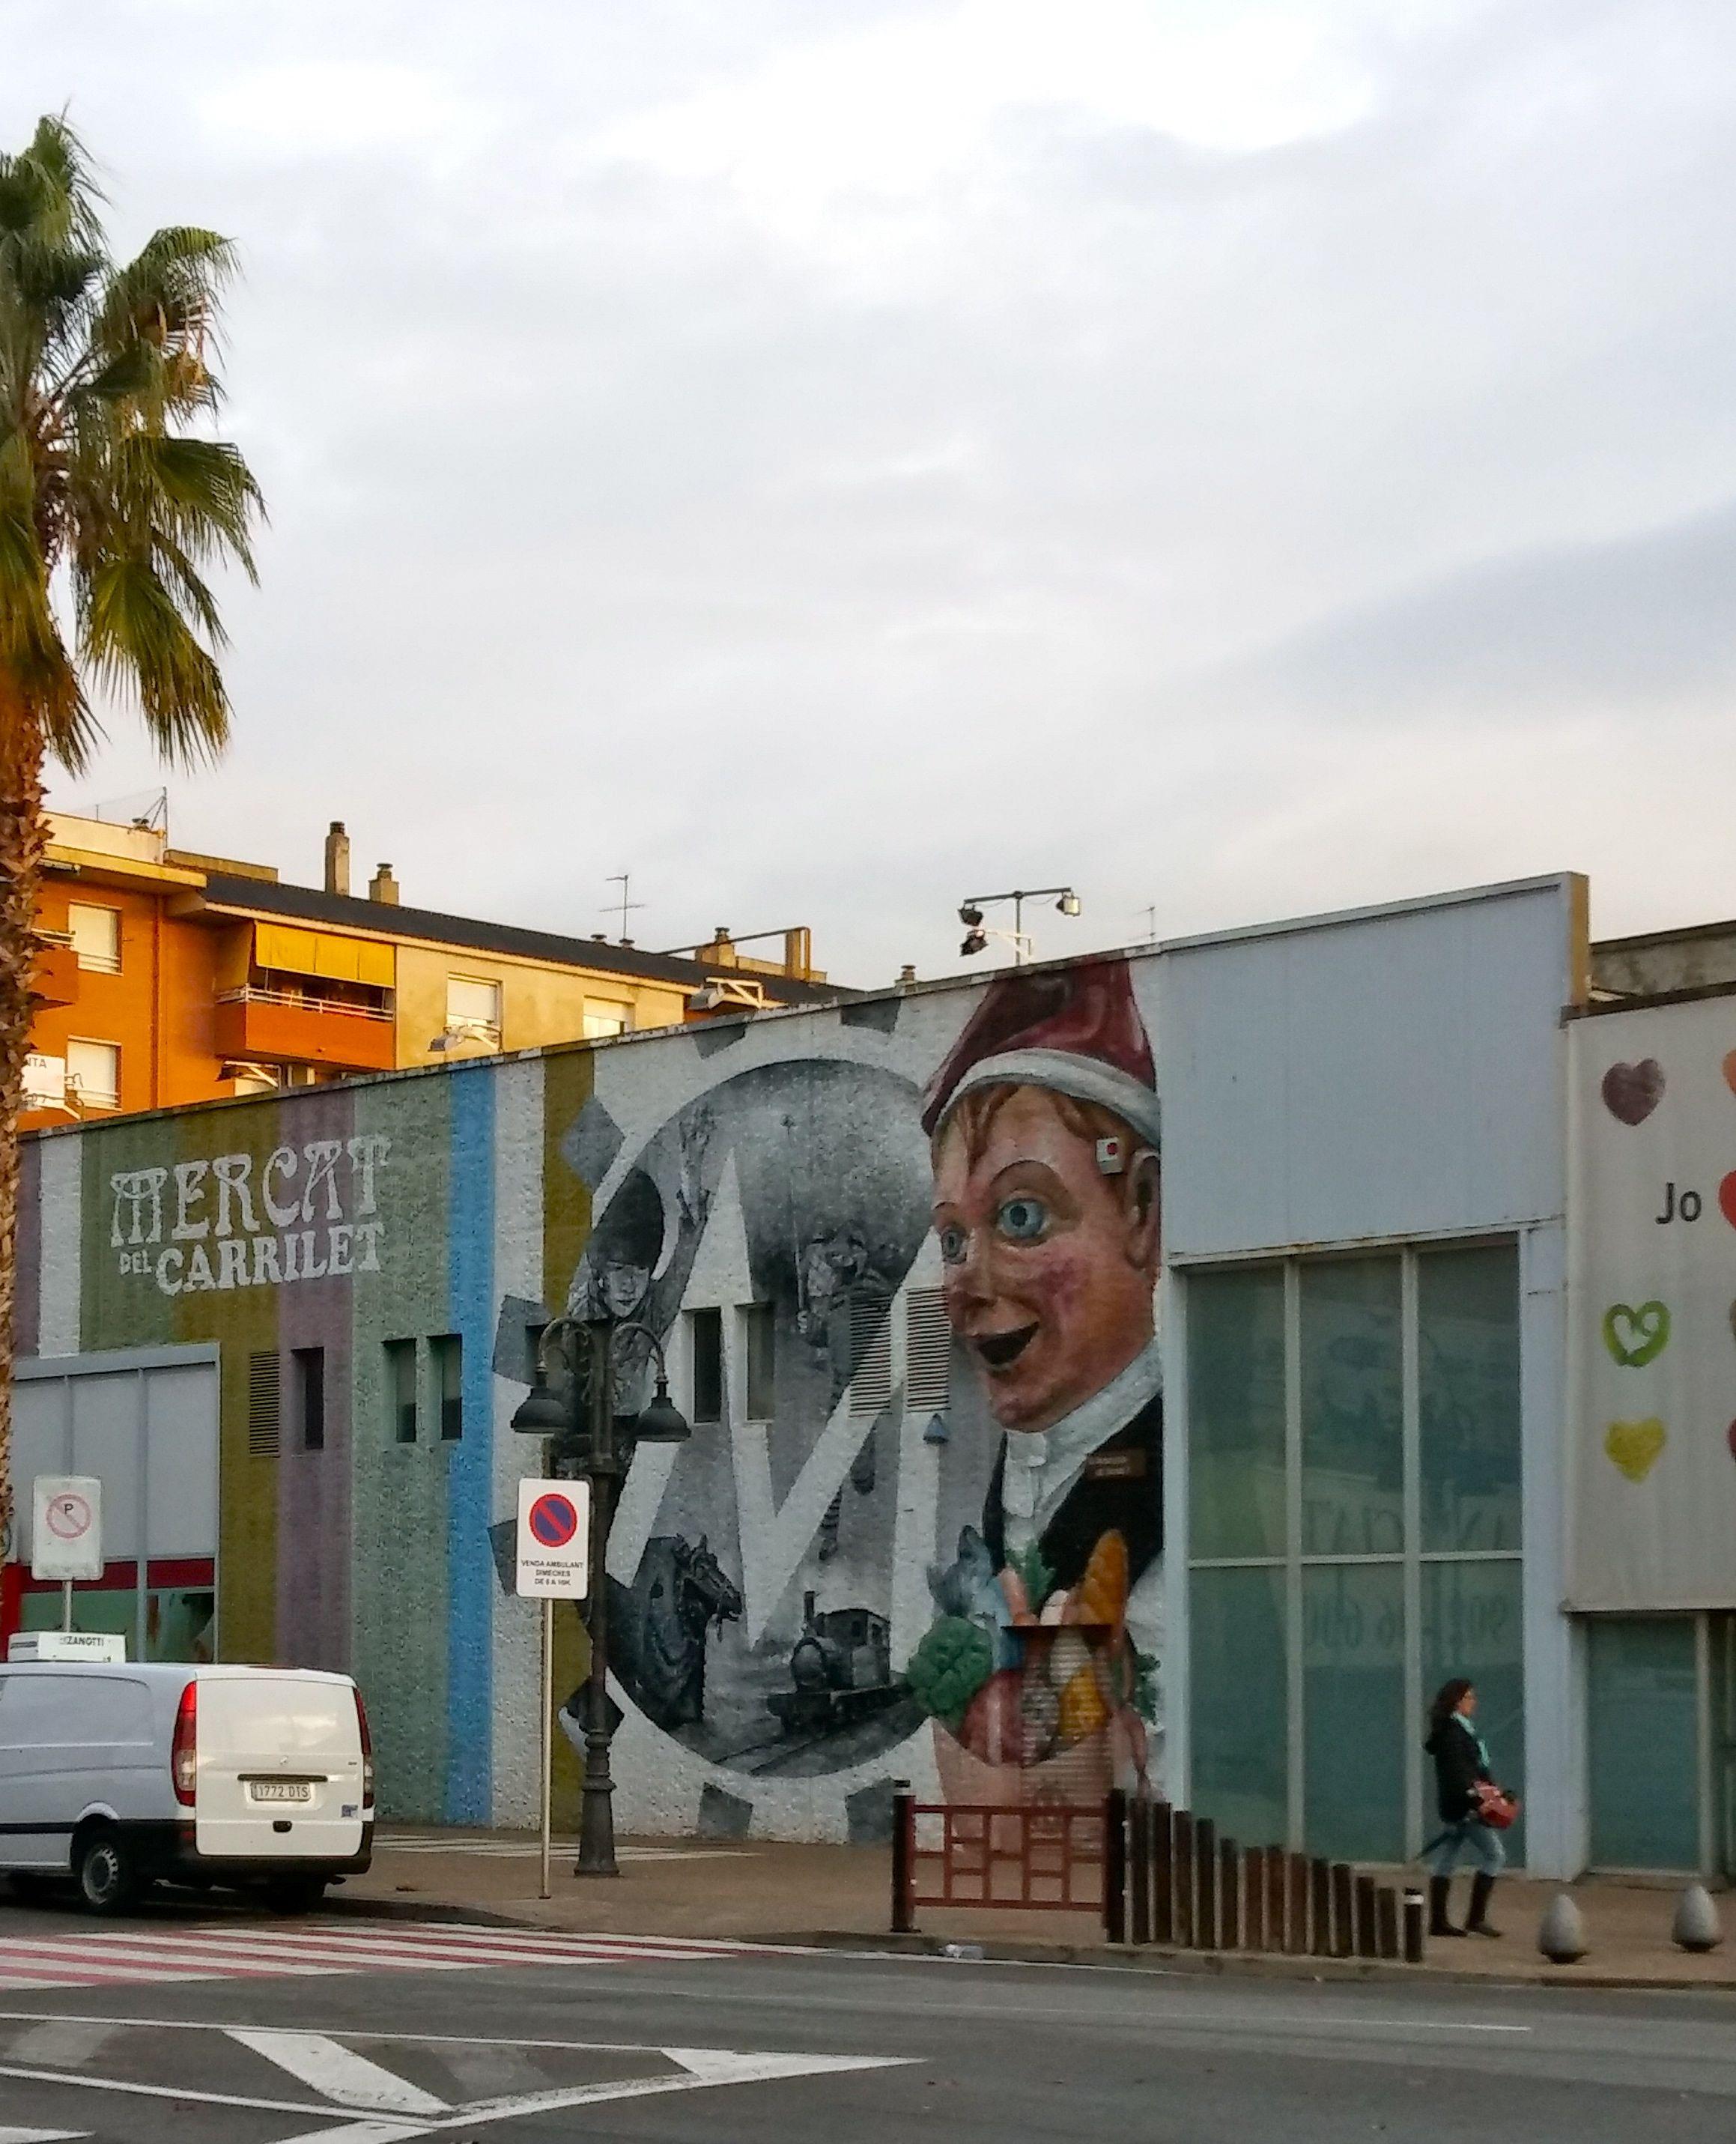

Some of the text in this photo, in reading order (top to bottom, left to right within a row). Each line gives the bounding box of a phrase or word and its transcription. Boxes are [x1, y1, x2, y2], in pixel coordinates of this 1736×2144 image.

[110, 1134, 392, 1247] MERCAT
[1655, 1182, 1702, 1224] Jo
[120, 1221, 385, 1297] DEL CARRILET
[64, 1503, 73, 1515] P
